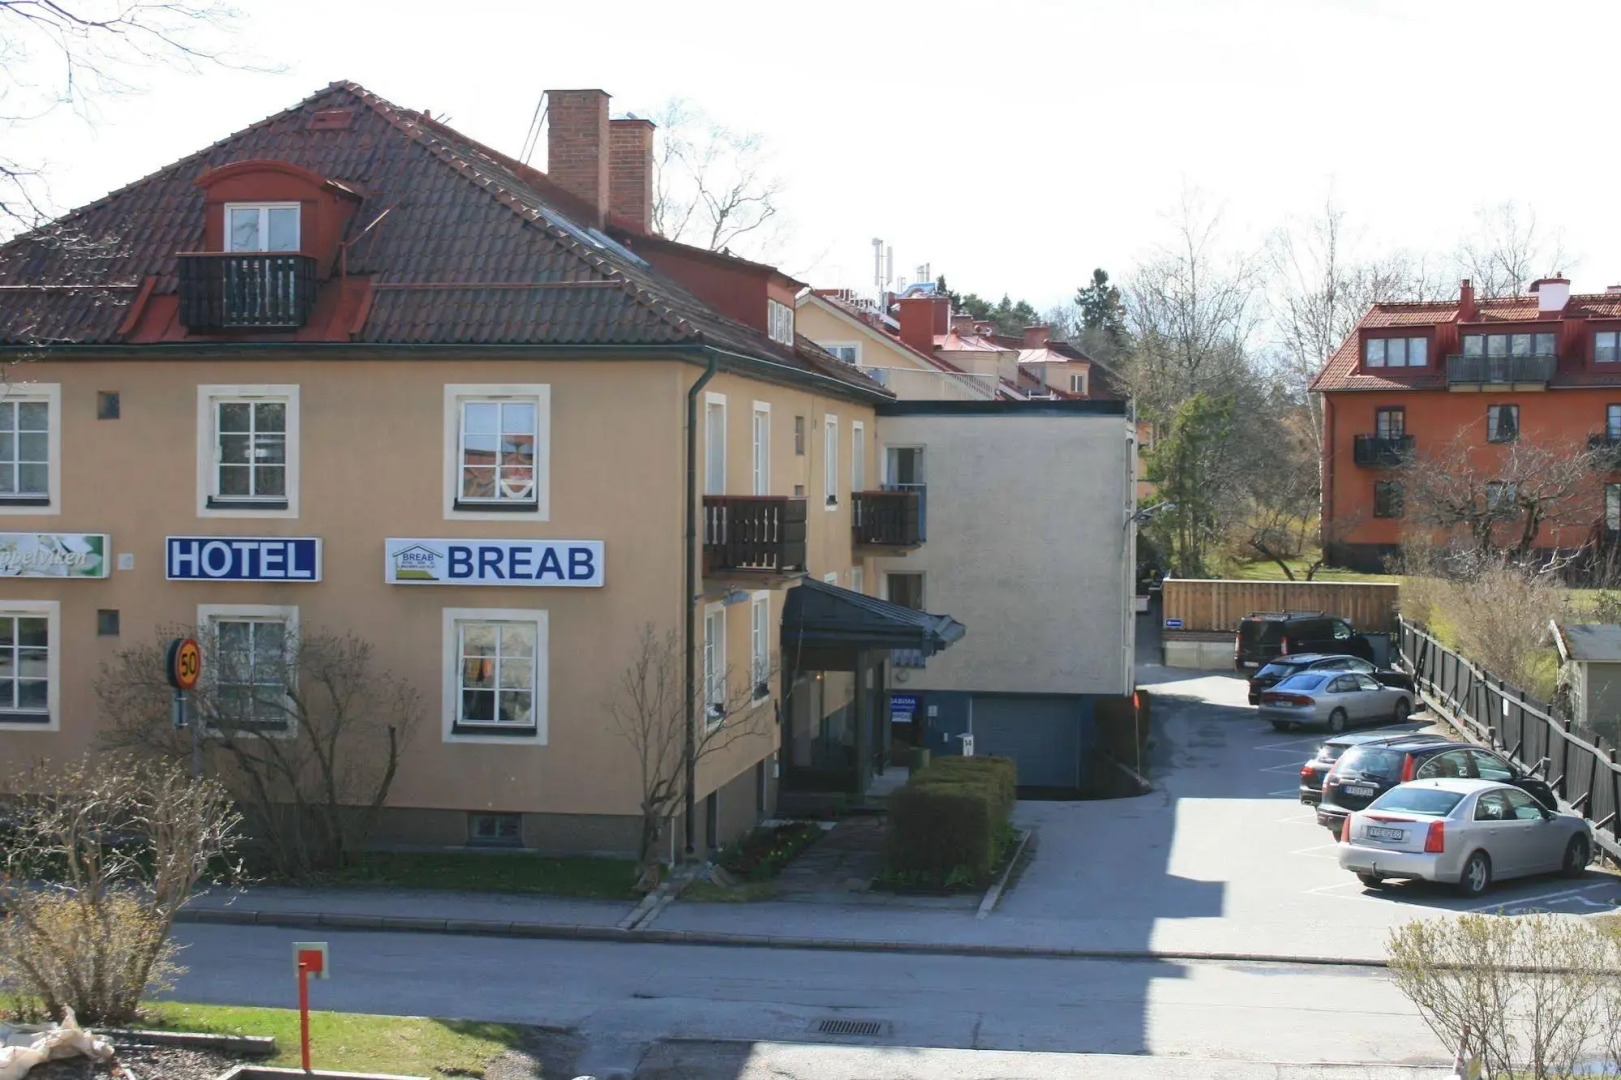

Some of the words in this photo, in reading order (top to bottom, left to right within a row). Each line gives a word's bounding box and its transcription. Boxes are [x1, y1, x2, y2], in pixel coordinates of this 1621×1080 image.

[172, 540, 312, 578] HOTEL
[402, 553, 434, 561] BREAB
[448, 546, 595, 580] BREAB
[181, 652, 197, 677] 50
